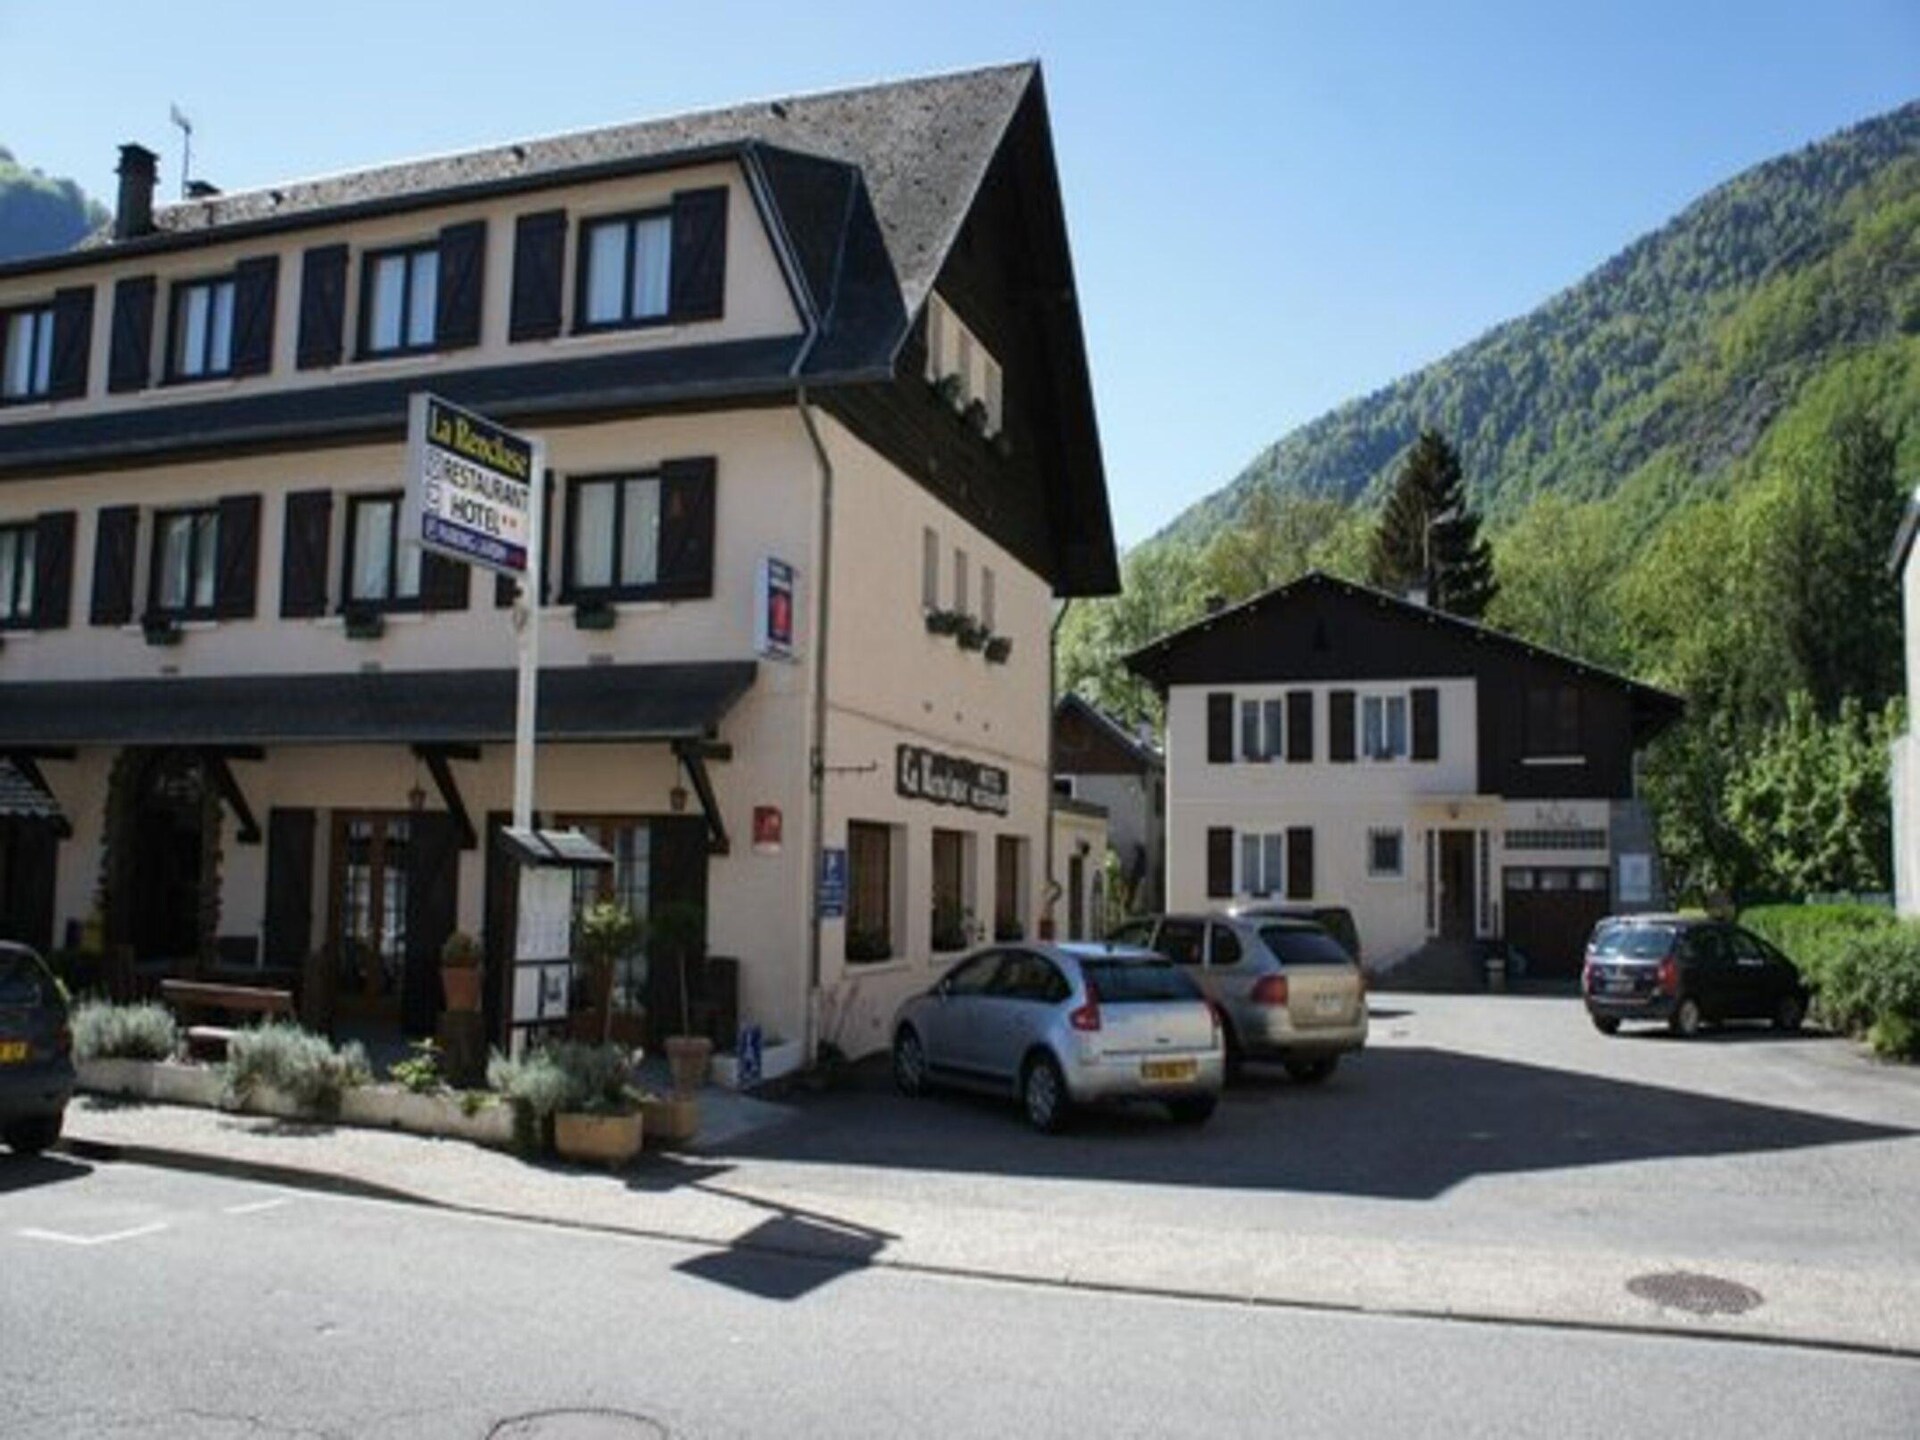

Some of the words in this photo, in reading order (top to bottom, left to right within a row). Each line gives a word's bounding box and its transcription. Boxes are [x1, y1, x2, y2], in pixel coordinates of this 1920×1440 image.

[433, 405, 451, 446] La
[444, 457, 529, 511] RESTAURANT
[452, 494, 501, 537] HOTEL
